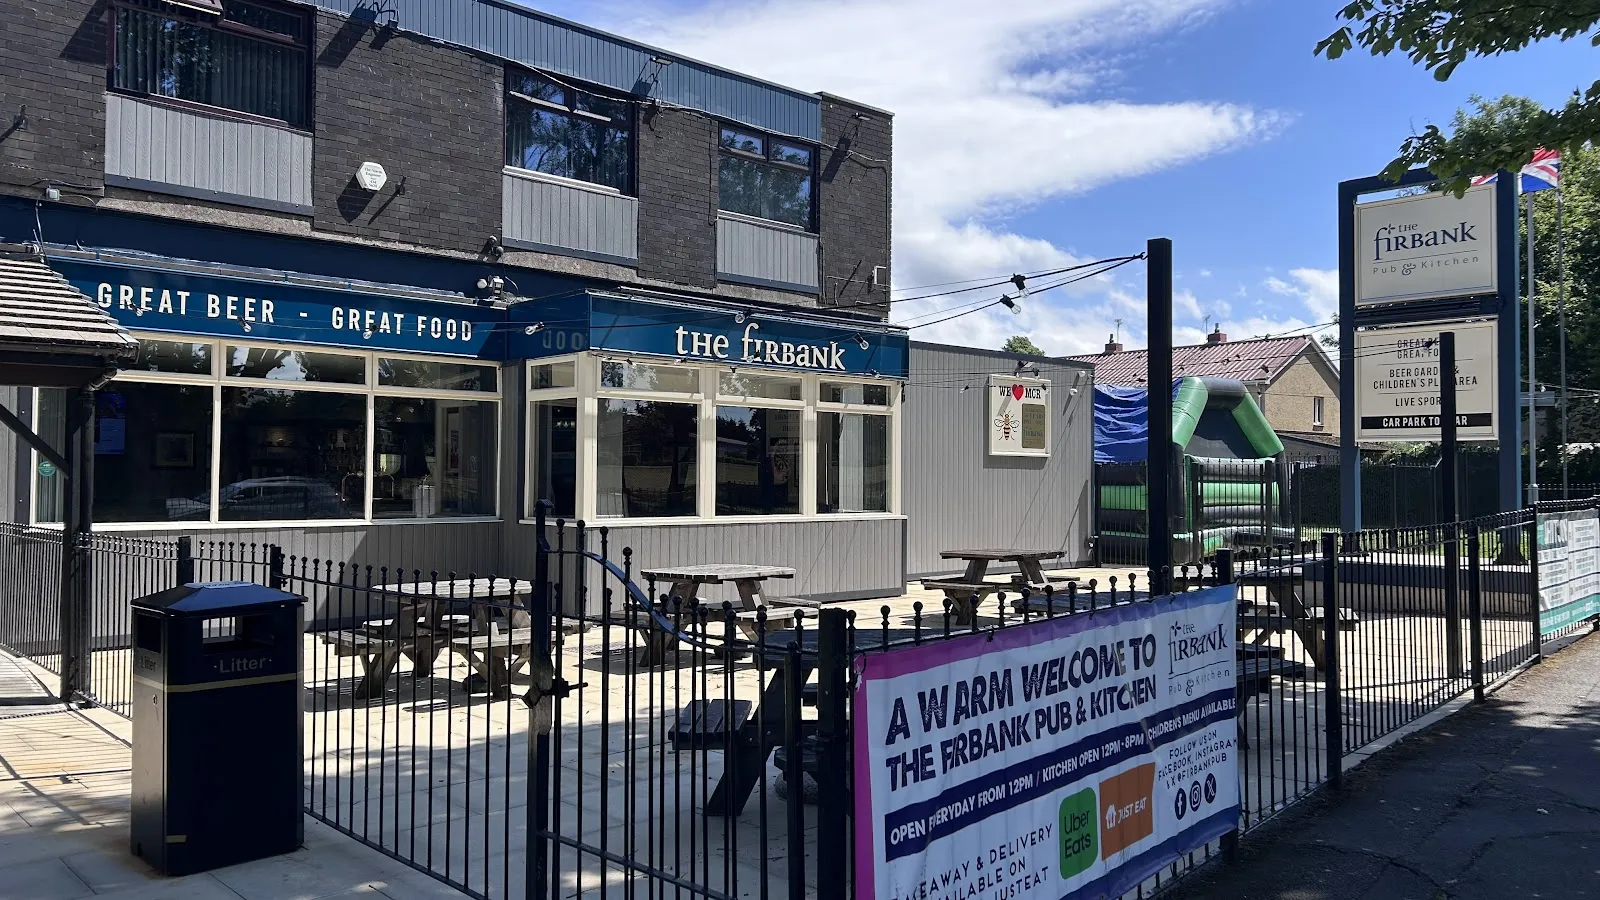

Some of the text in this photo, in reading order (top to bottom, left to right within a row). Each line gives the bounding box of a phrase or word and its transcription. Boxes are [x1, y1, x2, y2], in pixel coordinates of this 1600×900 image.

[1373, 256, 1479, 276] Pub & Kitchen
[97, 282, 190, 316] GREAT
[207, 293, 275, 323] BEER
[331, 306, 404, 335] GREAT
[417, 315, 472, 342] FOOD
[1397, 349, 1424, 359] GREA
[1389, 368, 1412, 378] BEER
[1414, 366, 1439, 377] GARD
[999, 385, 1041, 399] WE MCR
[1373, 377, 1425, 390] CHILDREN'S
[1395, 396, 1441, 407] LIVE SPOR
[1382, 417, 1400, 428] CAR
[1402, 416, 1427, 427] PARK
[1428, 416, 1440, 426] TO
[141, 655, 156, 672] Litter
[219, 656, 266, 674] Litter
[885, 633, 1157, 745] A WARM WELCOME TO
[1168, 669, 1230, 697] Pub & Kitchen
[885, 744, 936, 792] THE
[1034, 701, 1072, 740] PUB
[1075, 696, 1088, 726] &
[1090, 674, 1157, 720] KITCHEN
[1169, 740, 1197, 760] FOLLOW
[890, 819, 926, 845] OPEN
[978, 784, 1006, 809] FROM
[1008, 773, 1033, 796] 12PM
[1042, 756, 1078, 783] KITCHEN
[1079, 747, 1100, 767] OPEN
[1101, 740, 1121, 758] 12PM
[1124, 732, 1145, 749] 8PM
[1182, 708, 1200, 727] MENU
[1201, 697, 1236, 719] AVAILABLE
[1118, 797, 1147, 824] JUST EAT
[1064, 809, 1090, 835] Uber
[976, 855, 984, 871] &
[989, 823, 1053, 865] DELIVERY
[1064, 832, 1092, 859] Eats
[1009, 856, 1026, 877] ON
